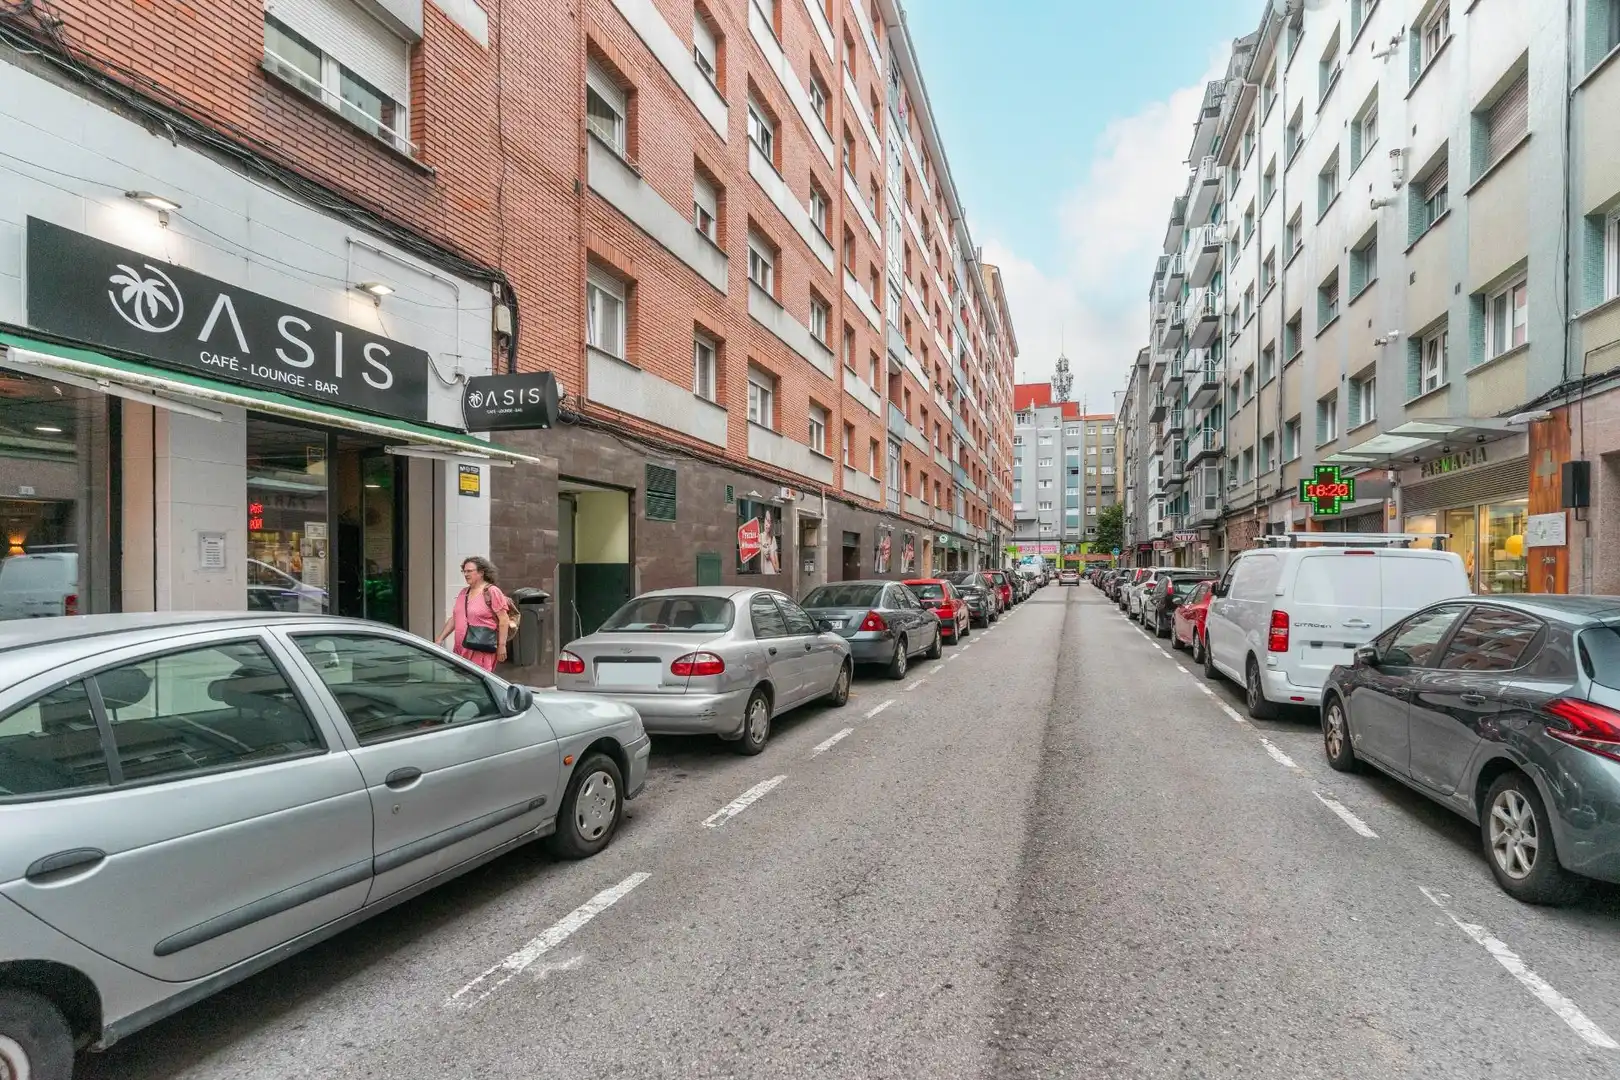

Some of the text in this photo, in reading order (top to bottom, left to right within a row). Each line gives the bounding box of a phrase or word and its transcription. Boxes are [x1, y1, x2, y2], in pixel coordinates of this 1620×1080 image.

[200, 351, 239, 371] CAFÉ
[251, 364, 305, 388] LOUNGE
[315, 380, 339, 396] BAR
[1421, 446, 1487, 479] FARMACIA
[1307, 484, 1349, 497] 18:20
